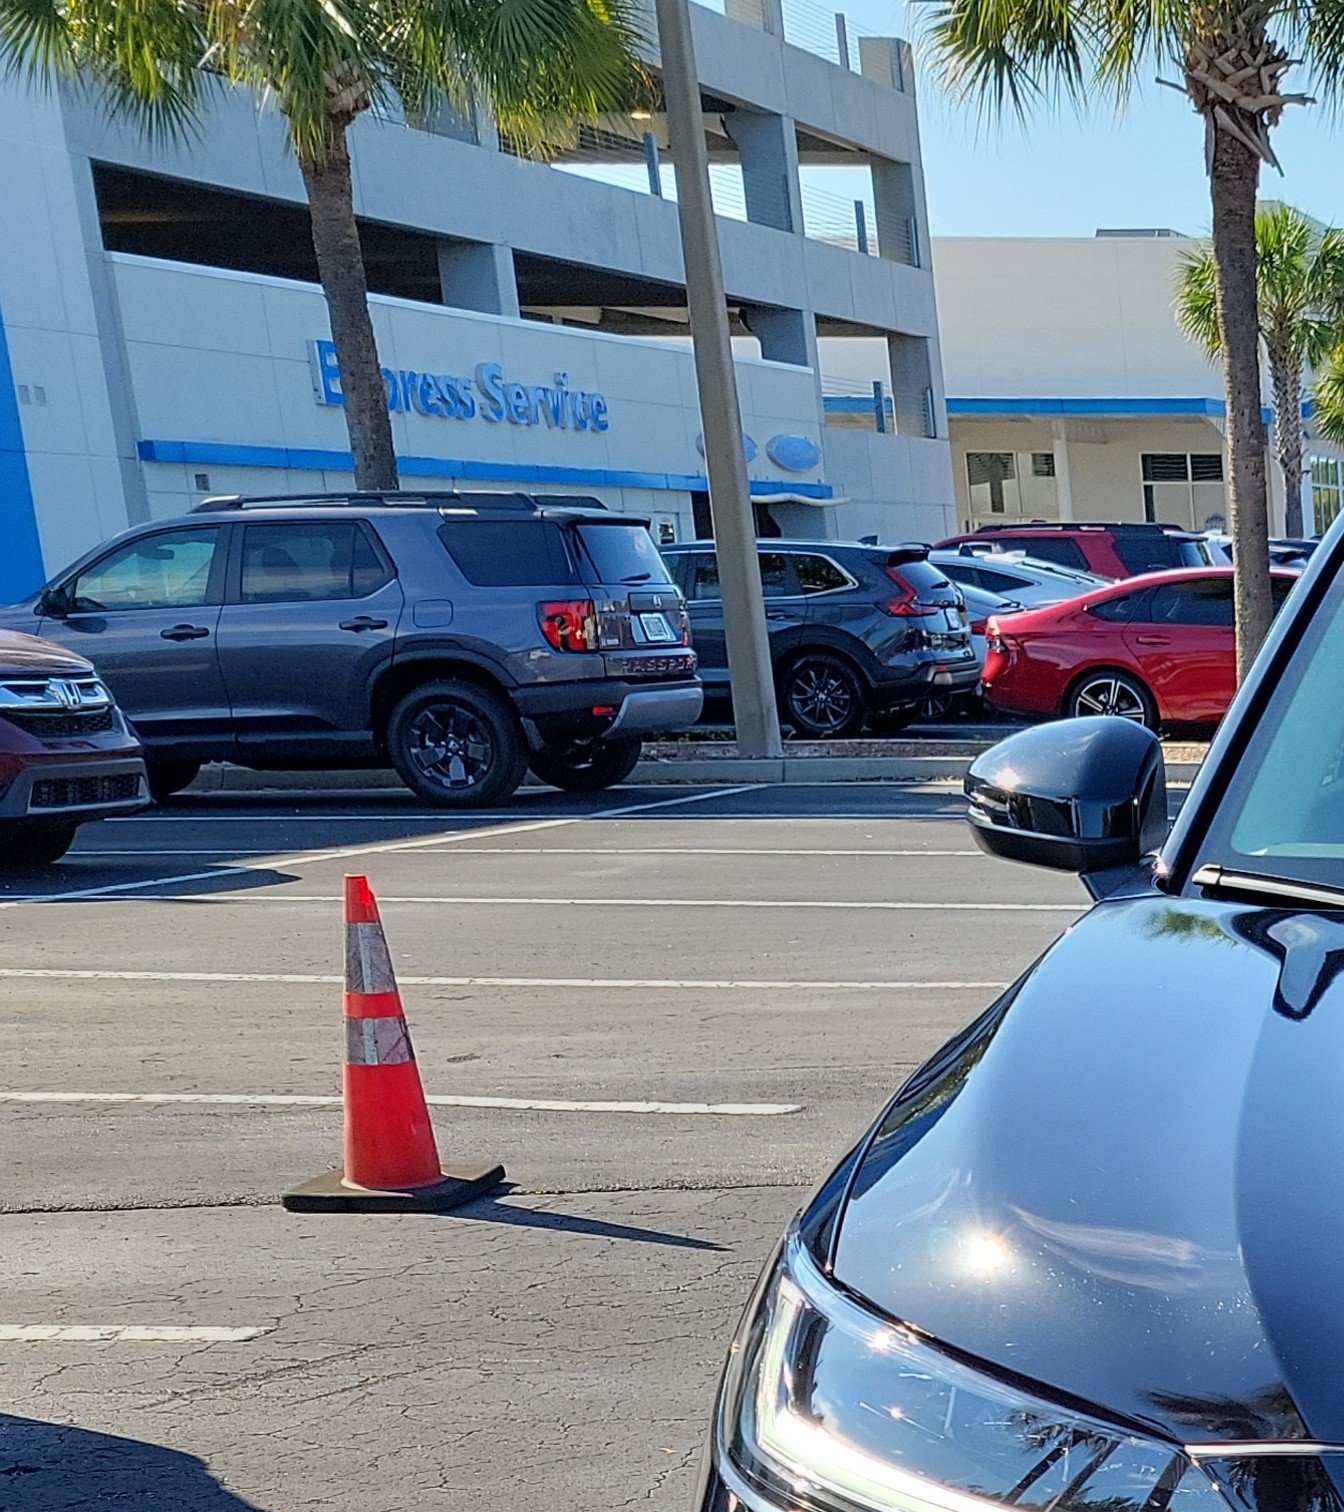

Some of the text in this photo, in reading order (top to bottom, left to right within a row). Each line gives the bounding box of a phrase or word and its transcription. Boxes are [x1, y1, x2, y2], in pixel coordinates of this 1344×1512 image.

[308, 339, 610, 431] Eress Service
[620, 656, 695, 673] PASSPO
